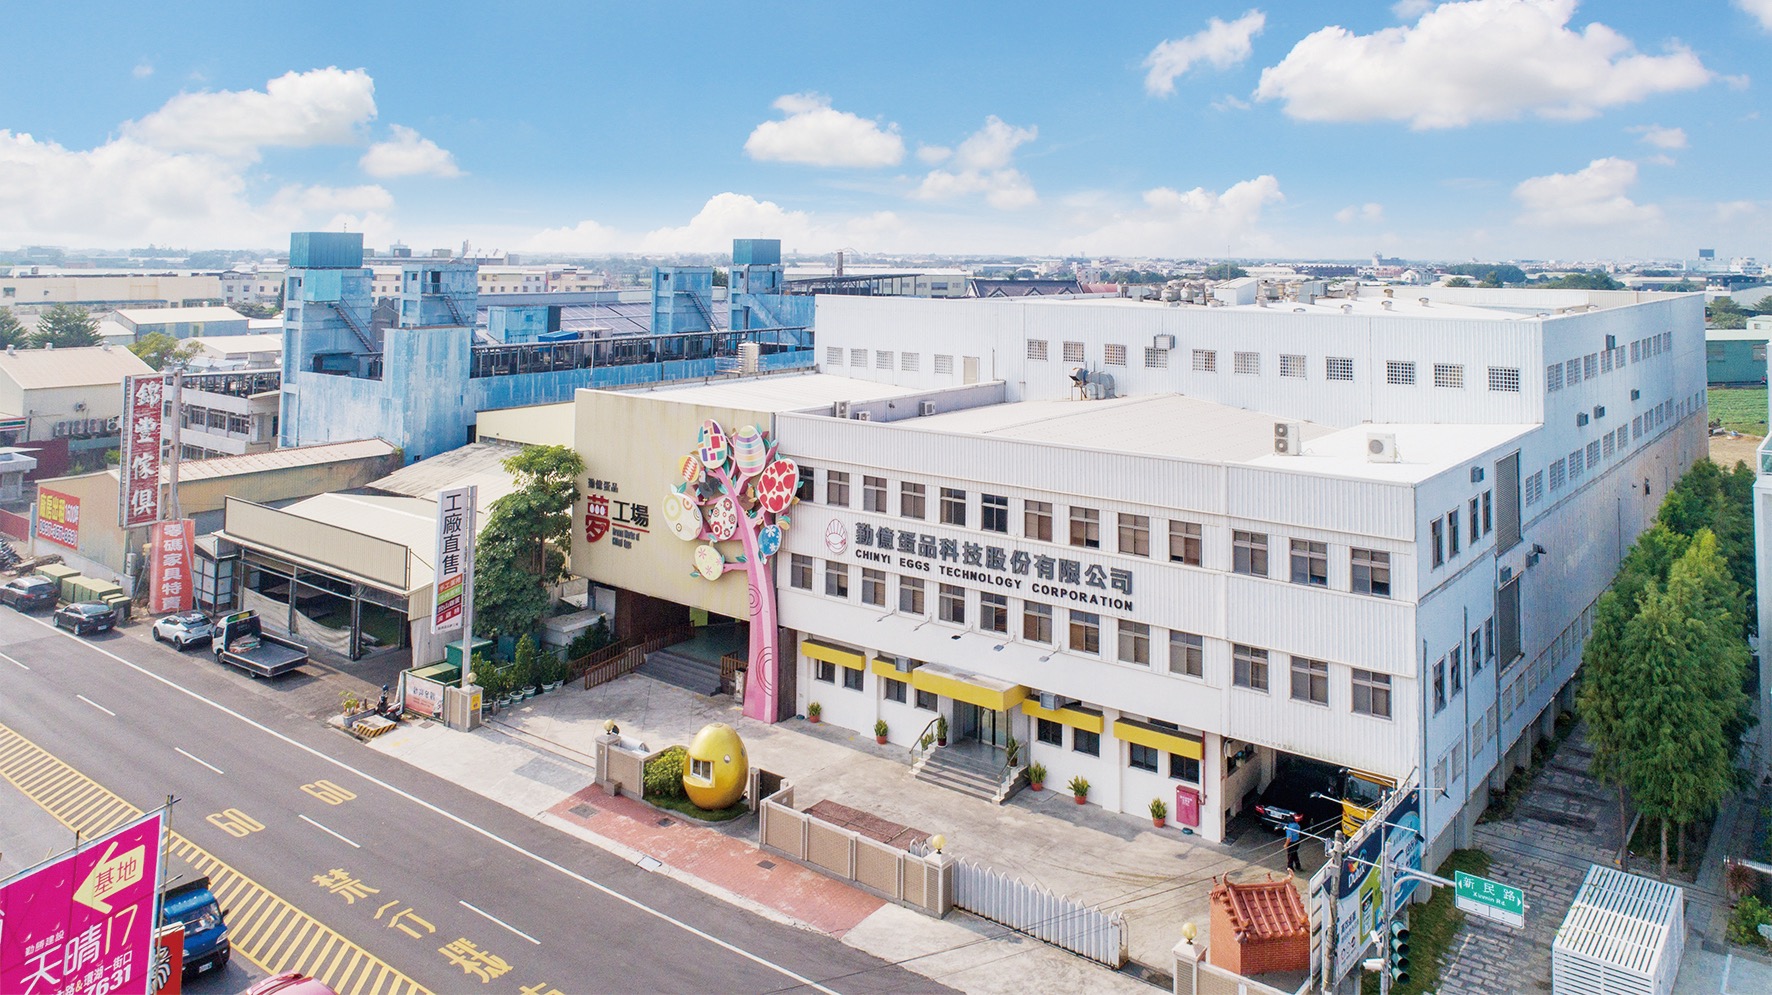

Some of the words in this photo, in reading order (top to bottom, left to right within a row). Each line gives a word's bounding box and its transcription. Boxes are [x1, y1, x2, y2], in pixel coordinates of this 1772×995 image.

[131, 381, 161, 516] 錦豐傢俱
[442, 494, 462, 575] 工廠直售
[585, 494, 649, 543] 夢工場
[162, 524, 182, 611] 零碼家具特賣
[855, 522, 1133, 595] 勤億蛋品科技股份有限公司
[855, 549, 891, 564] CHINYI
[900, 558, 930, 572] EGGS
[939, 565, 1021, 589] TECHNOLOGY
[1032, 583, 1133, 611] CORPORATION
[300, 779, 357, 805] 60
[205, 808, 266, 838] 60
[93, 856, 137, 898] 基地
[1463, 876, 1515, 902] 新民路
